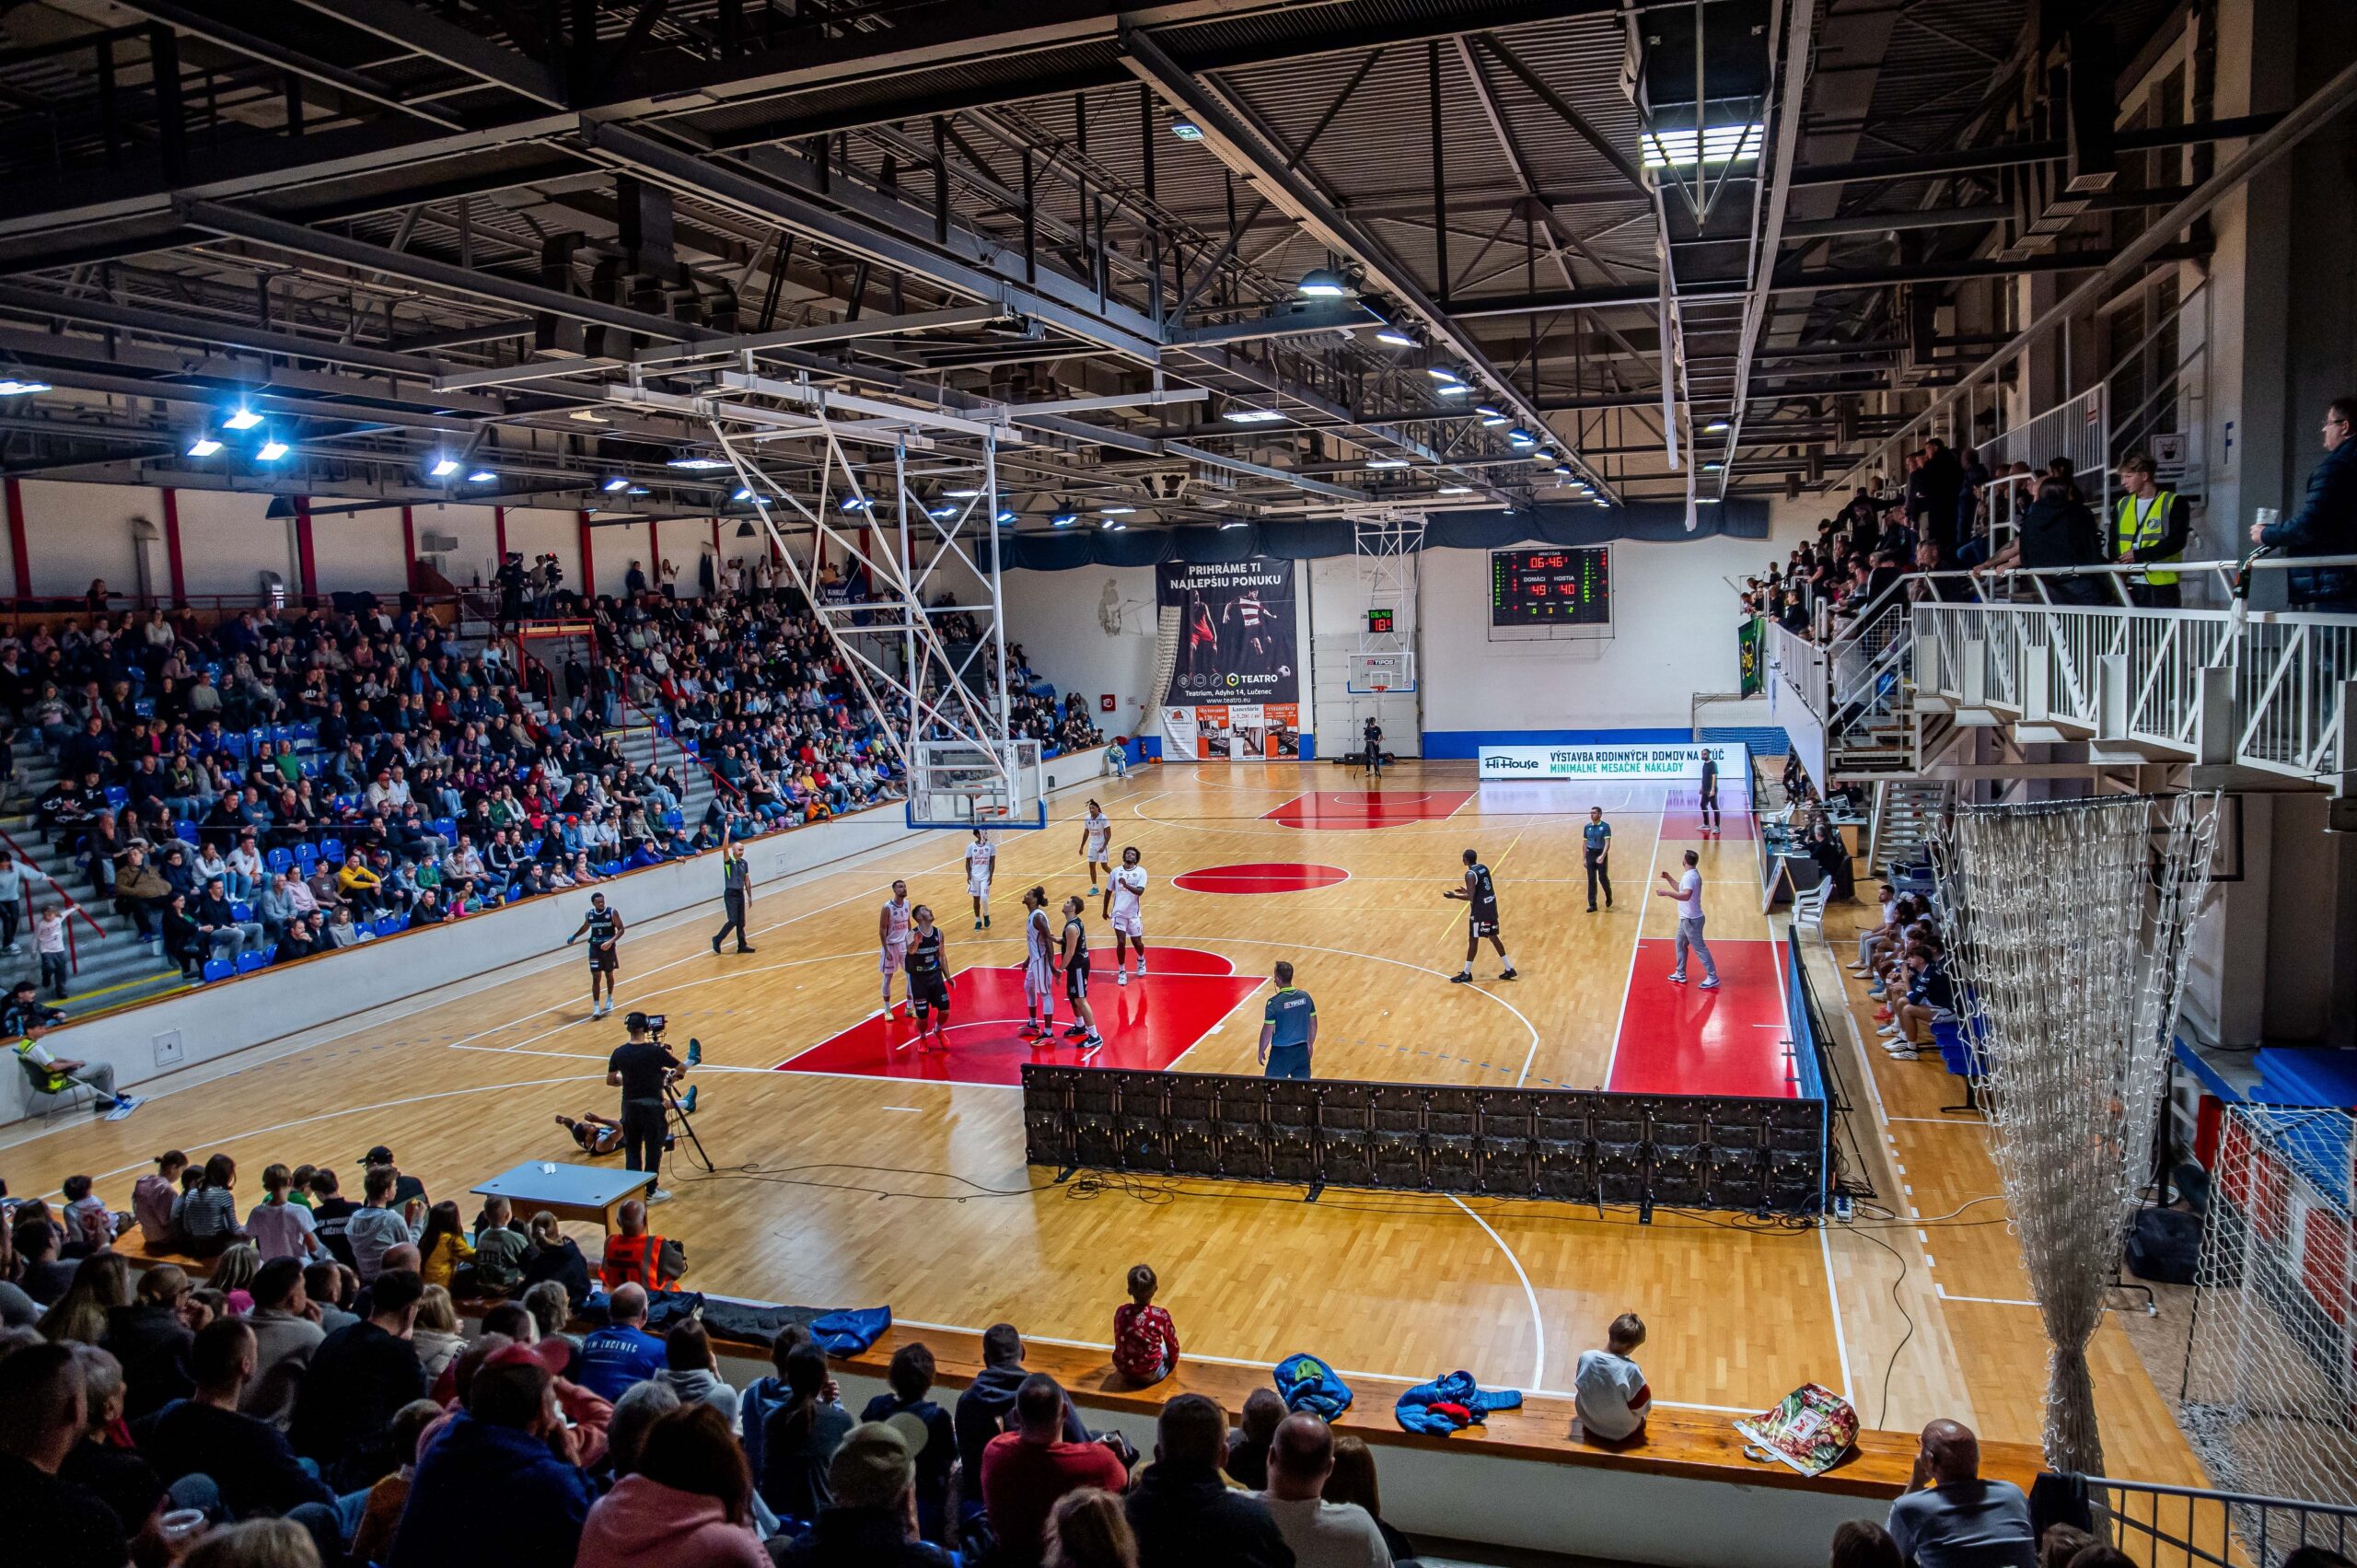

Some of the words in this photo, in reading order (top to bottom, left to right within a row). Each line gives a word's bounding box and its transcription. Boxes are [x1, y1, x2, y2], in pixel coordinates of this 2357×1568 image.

[1189, 563, 1248, 575] PRIHRÁME
[1250, 563, 1261, 573] TI
[1170, 576, 1229, 590] NAJLEPŠIU
[1232, 575, 1282, 587] PONUKU
[1531, 585, 1546, 596] 49
[1560, 584, 1575, 595] 40
[1240, 674, 1278, 683] TEATRO
[1215, 689, 1234, 698] Adyho
[1550, 750, 1594, 762] VÝSTAVBA
[1596, 749, 1648, 761] RODINNÝCH
[1652, 750, 1685, 761] DOMOV
[1687, 750, 1699, 761] NA
[1550, 762, 1597, 773] MINIMÁLNE
[1601, 761, 1641, 772] MESAČNÉ
[1644, 761, 1683, 772] NÁKLADY
[1483, 877, 1491, 890] 3
